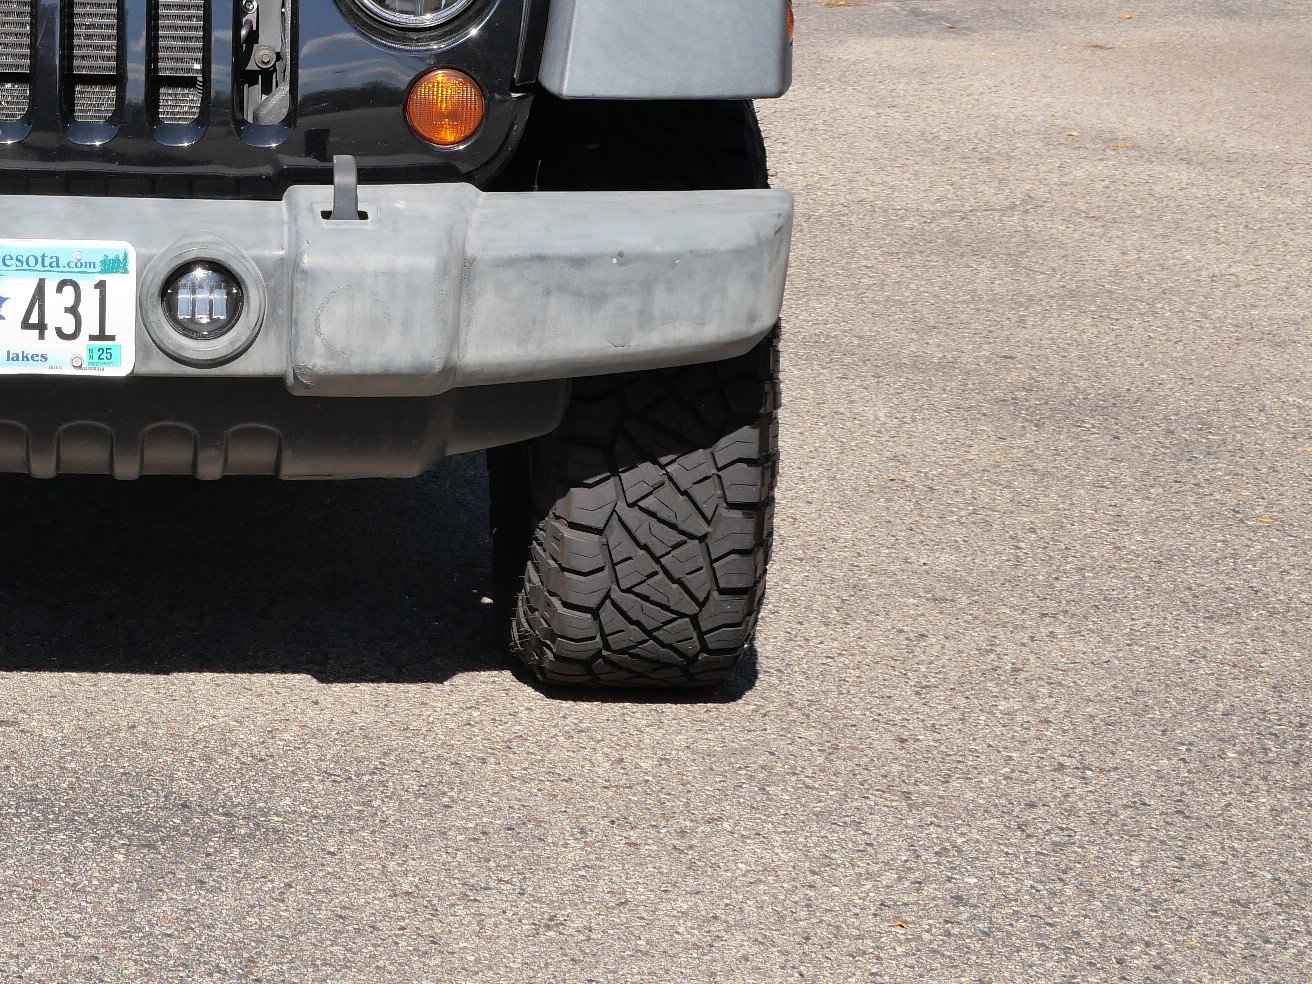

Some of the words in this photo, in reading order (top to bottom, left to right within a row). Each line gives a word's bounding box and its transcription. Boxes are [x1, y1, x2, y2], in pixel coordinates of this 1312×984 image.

[20, 277, 116, 342] 431
[6, 349, 48, 363] lakes
[97, 347, 113, 361] 25
